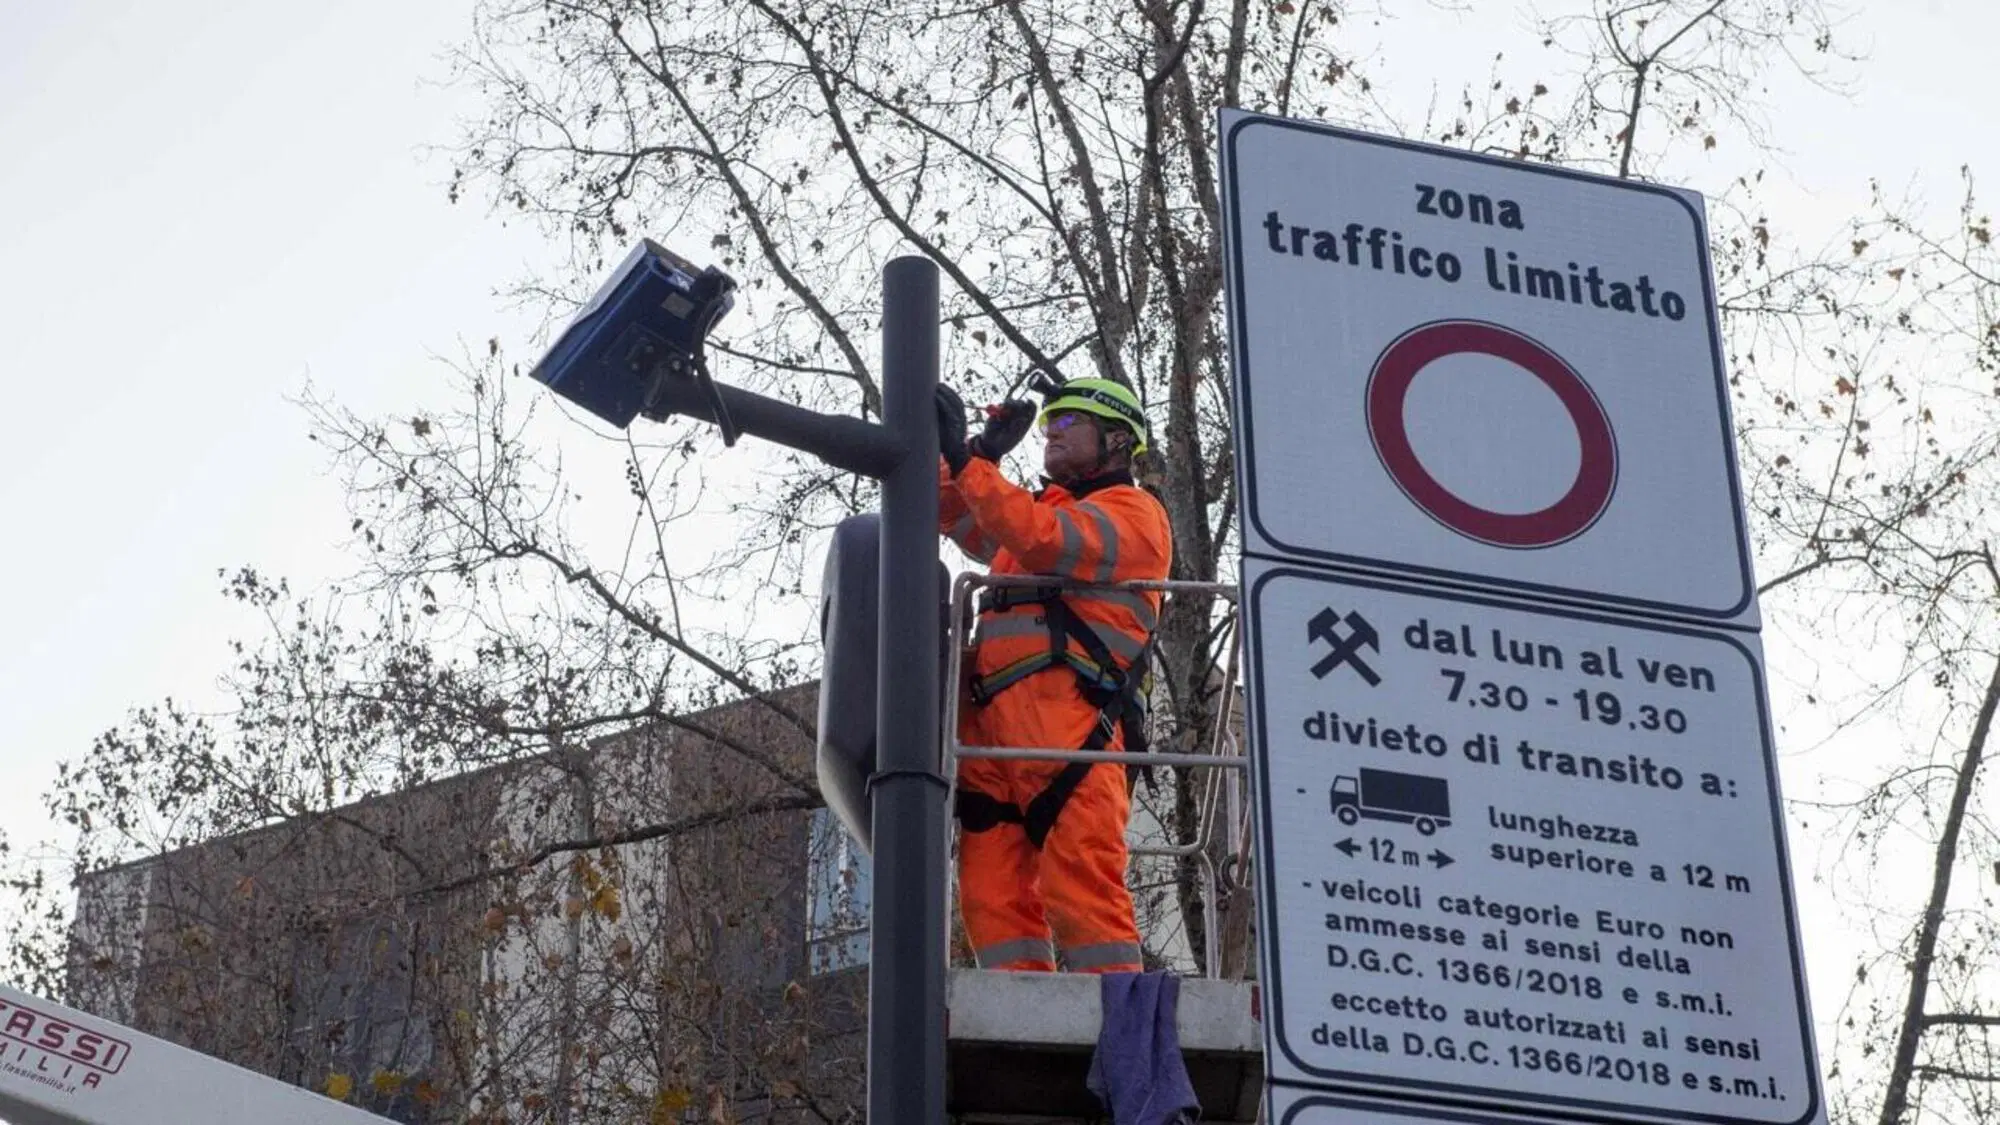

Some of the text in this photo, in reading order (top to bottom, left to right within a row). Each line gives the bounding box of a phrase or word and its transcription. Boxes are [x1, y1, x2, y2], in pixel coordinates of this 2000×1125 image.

[1415, 183, 1525, 231] zona
[1262, 210, 1686, 322] traffico limitato
[1404, 618, 1716, 693] dal lun al ven
[1440, 668, 1529, 712] 7.30
[1573, 688, 1687, 735] 19.30
[1302, 710, 1737, 798] divieto di transito a:
[1488, 805, 1639, 847] lunghezza
[1490, 843, 1751, 894] superiore a 12 m
[1321, 879, 1421, 909] veicoli
[1437, 895, 1580, 930] categorie
[1596, 909, 1665, 941] Euro
[1680, 926, 1734, 950] non
[1325, 913, 1692, 976] ammesse ai sensi della
[1327, 943, 1733, 1017] D.G.C. 1366/2018 e s.m.i.
[0, 1002, 117, 1067] ASSI
[1311, 1022, 1786, 1102] della D.G.C. 1366/2018 e s.m.i.
[1330, 992, 1761, 1062] eccetto autorizzati ai sensi
